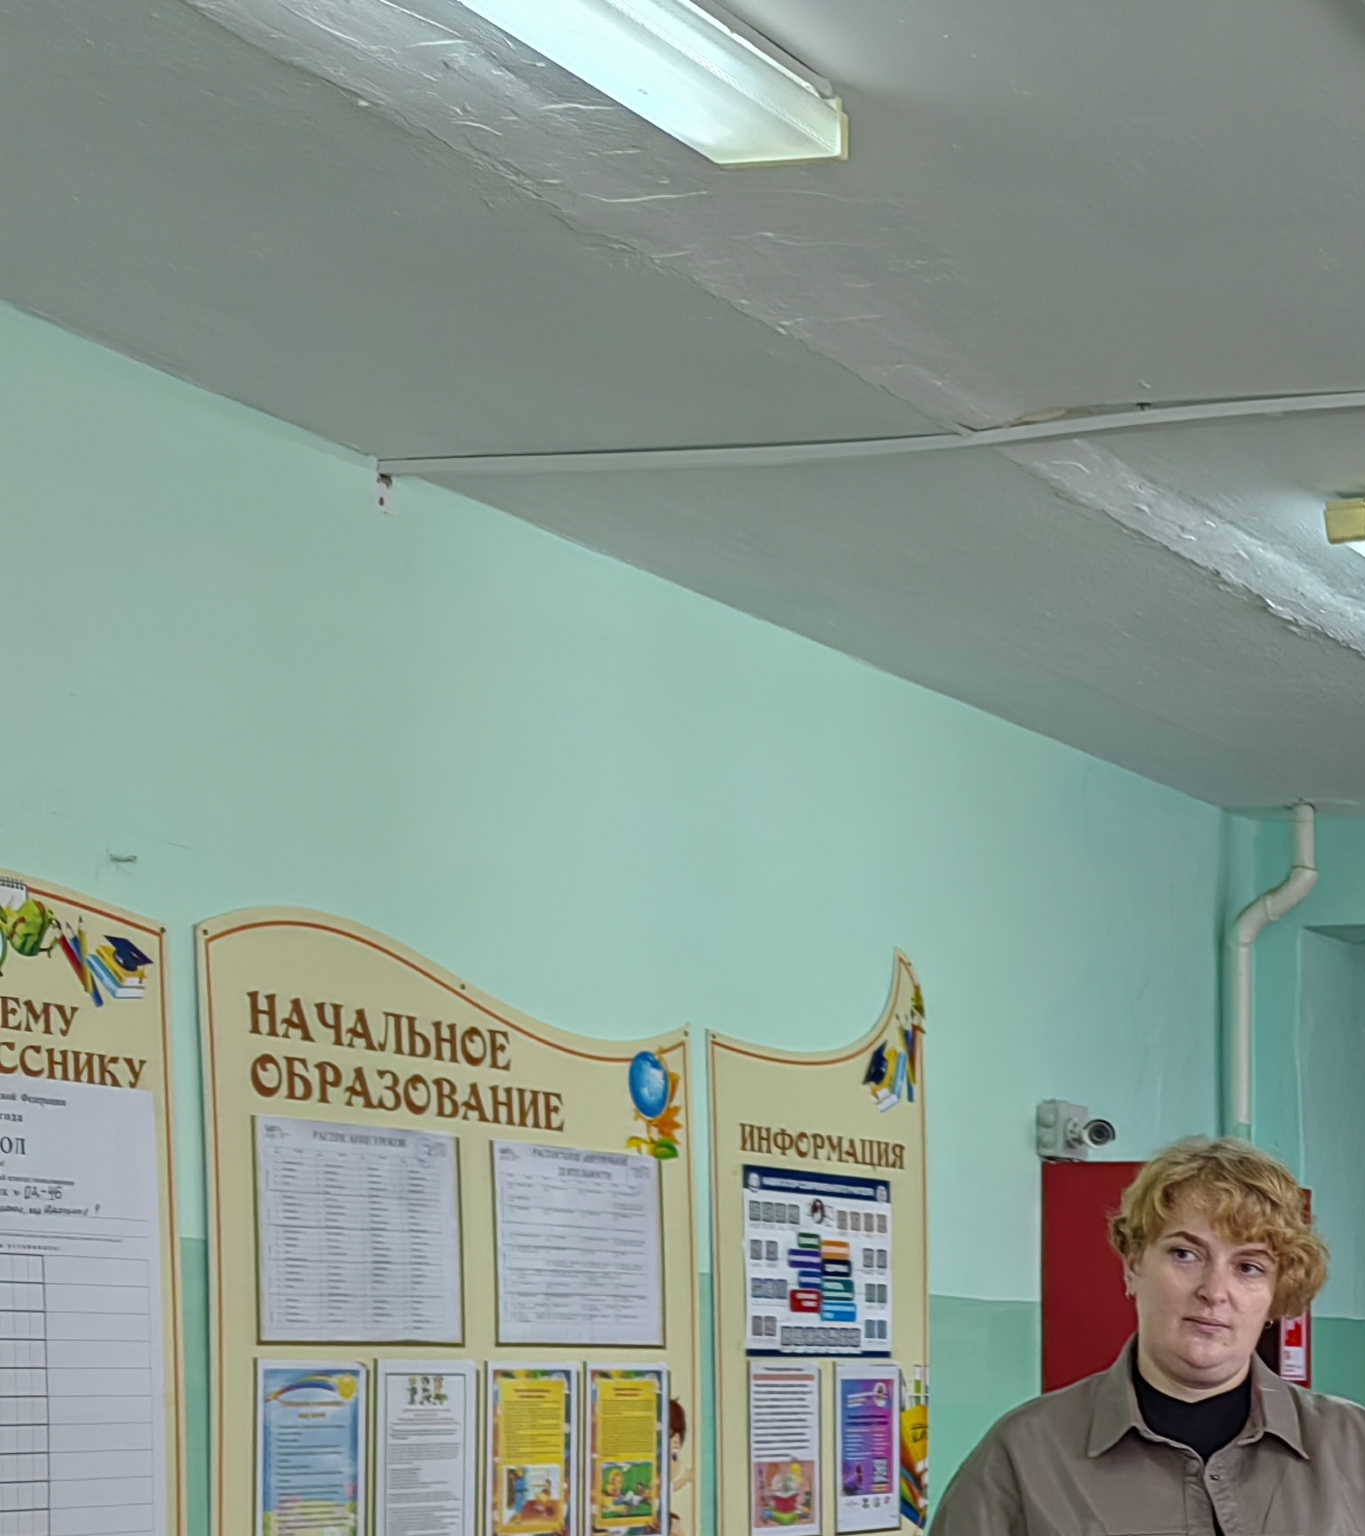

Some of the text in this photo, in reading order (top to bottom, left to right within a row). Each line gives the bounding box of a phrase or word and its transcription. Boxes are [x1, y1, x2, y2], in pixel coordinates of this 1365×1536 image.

[247, 990, 511, 1071] НАЧАЛЬНОЕ
[250, 1053, 565, 1132] ОБРАЗОВАНИЕ
[739, 1122, 906, 1170] ИНФОРМАЦИЯ
